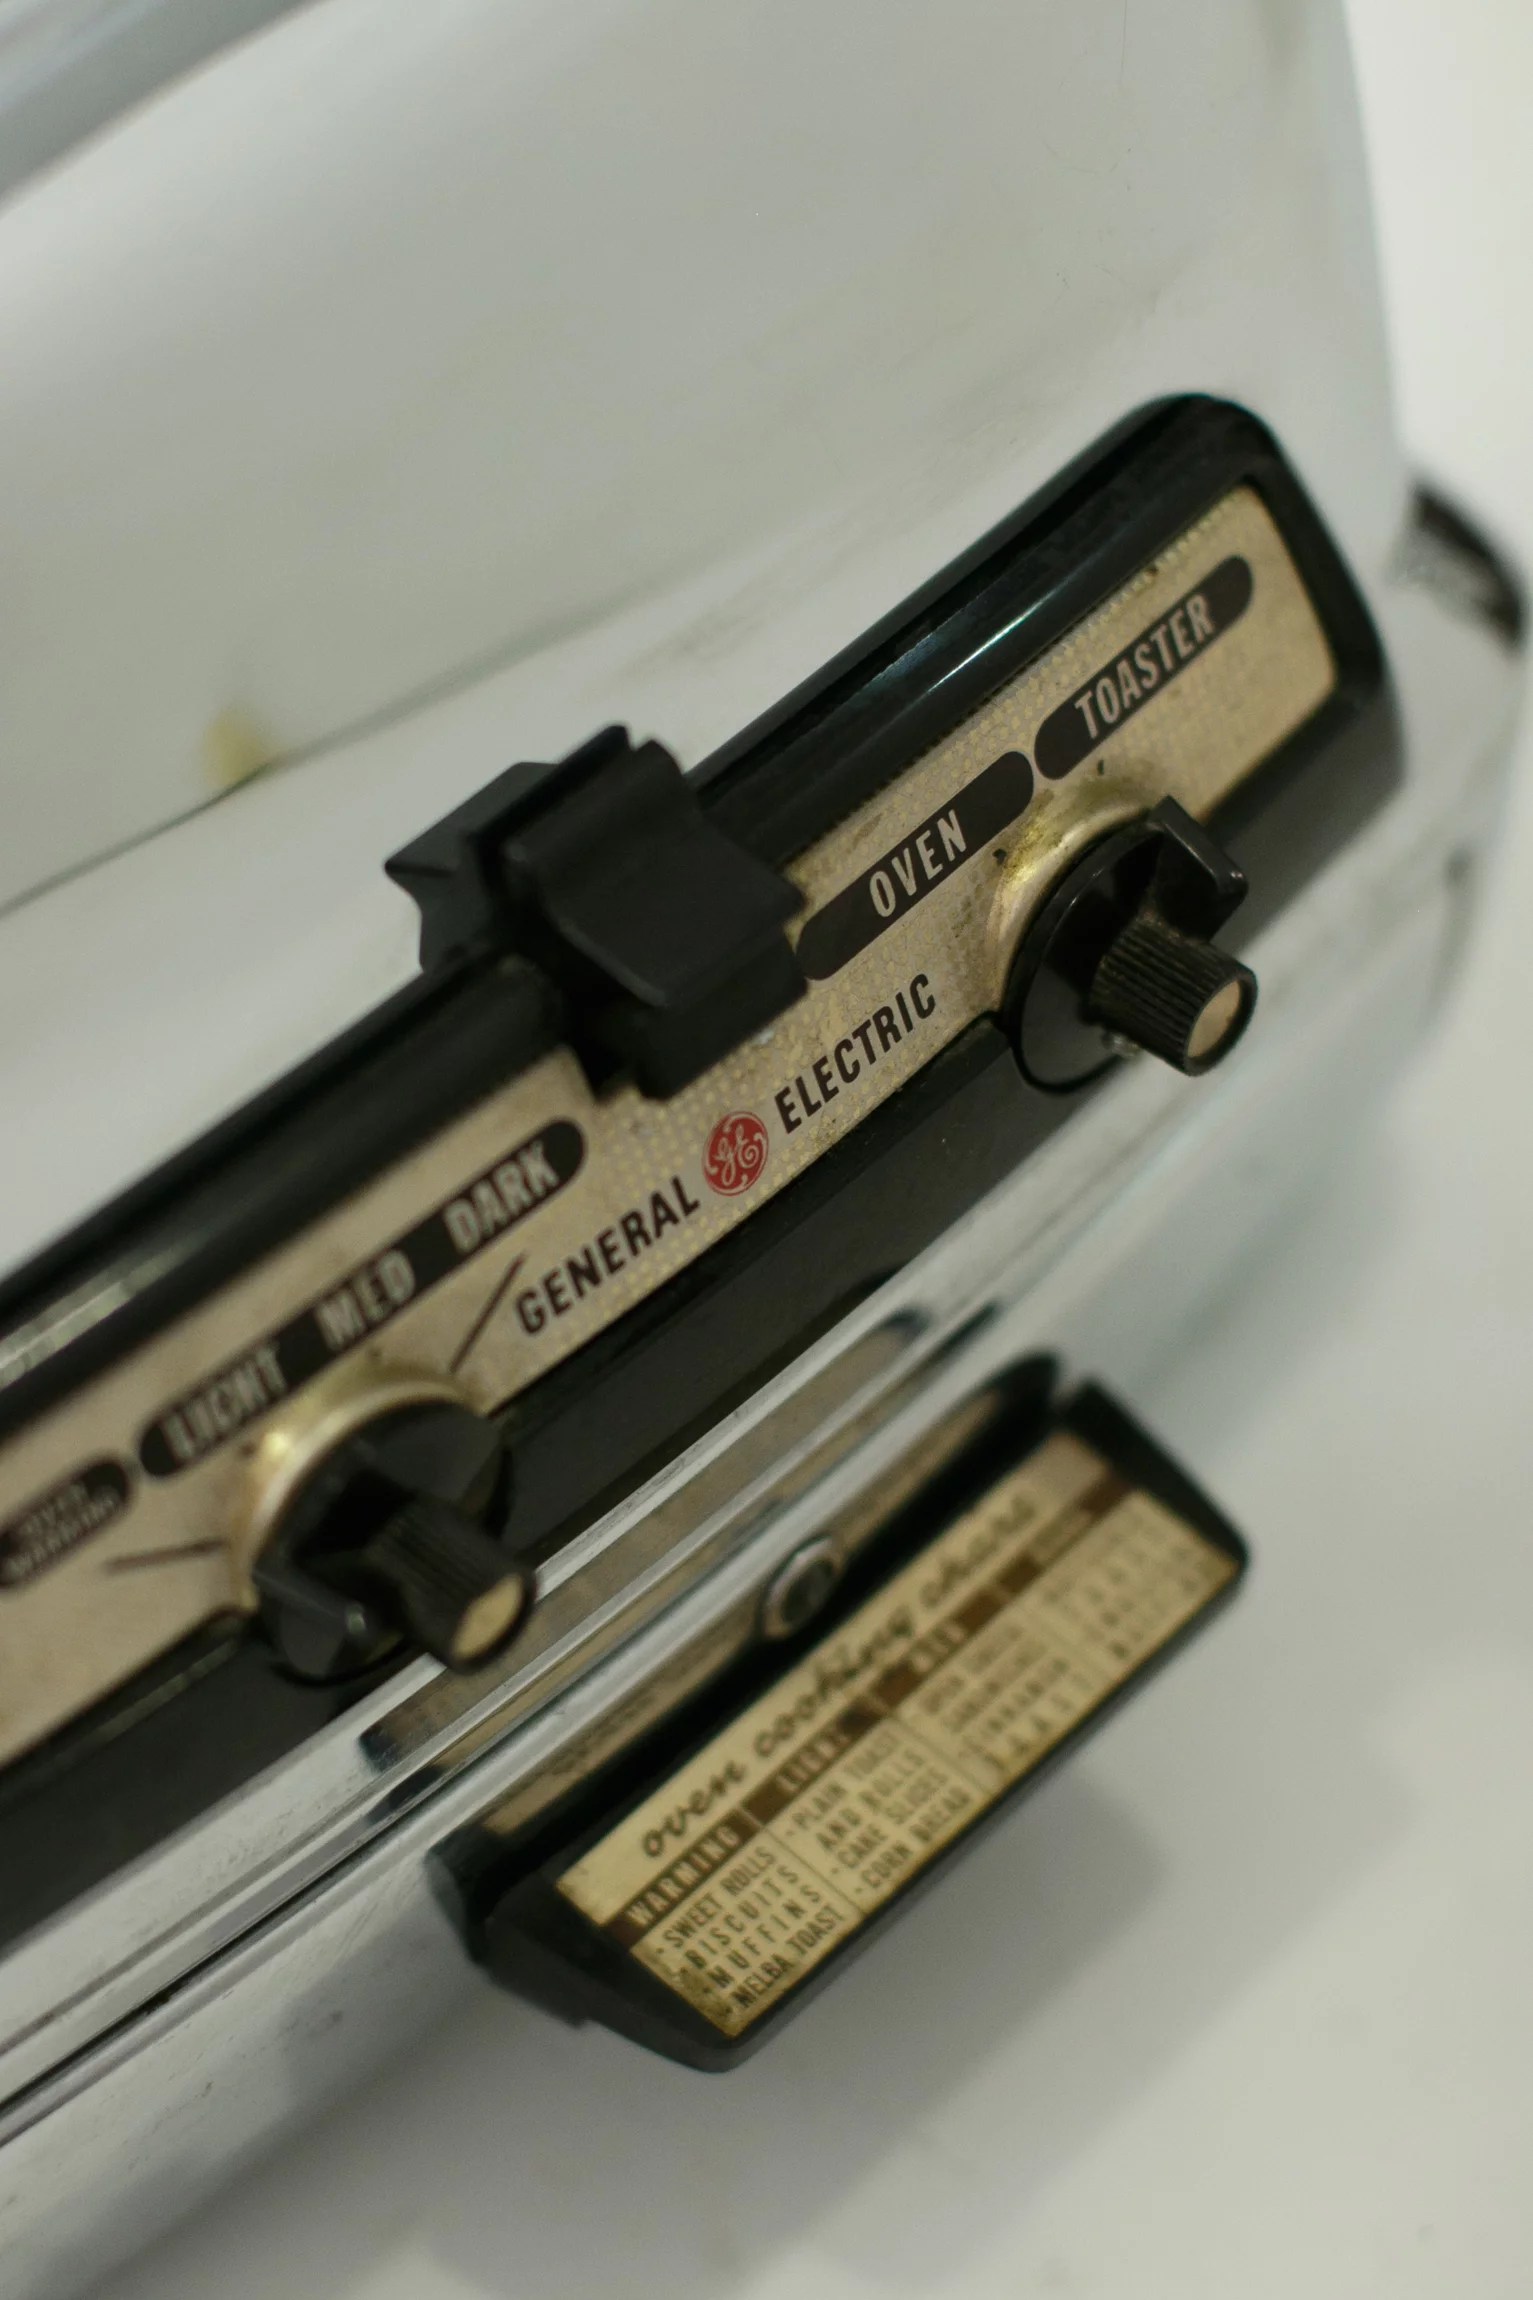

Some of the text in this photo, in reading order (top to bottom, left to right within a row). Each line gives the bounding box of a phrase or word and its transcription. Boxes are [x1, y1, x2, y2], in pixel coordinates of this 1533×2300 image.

[1074, 593, 1217, 739] TOASTER
[869, 808, 967, 918] OVEN
[515, 1175, 700, 1335] GENERAL
[773, 973, 937, 1134] ELECTRIC
[161, 1138, 561, 1463] LIGHT MED DARK
[642, 1760, 748, 1858] oven
[791, 1782, 847, 1831] PLAIN
[815, 1807, 861, 1852] AND
[837, 1823, 888, 1870] CAKE
[860, 1785, 972, 1889] CORN BREAD
[626, 1823, 740, 1927] WARMING
[661, 1845, 777, 1951] SWEET ROLLS
[685, 1864, 799, 1970] BISCUITS
[706, 1883, 821, 1990] MUFFINS
[730, 1904, 846, 2009] MELBA TOAST
